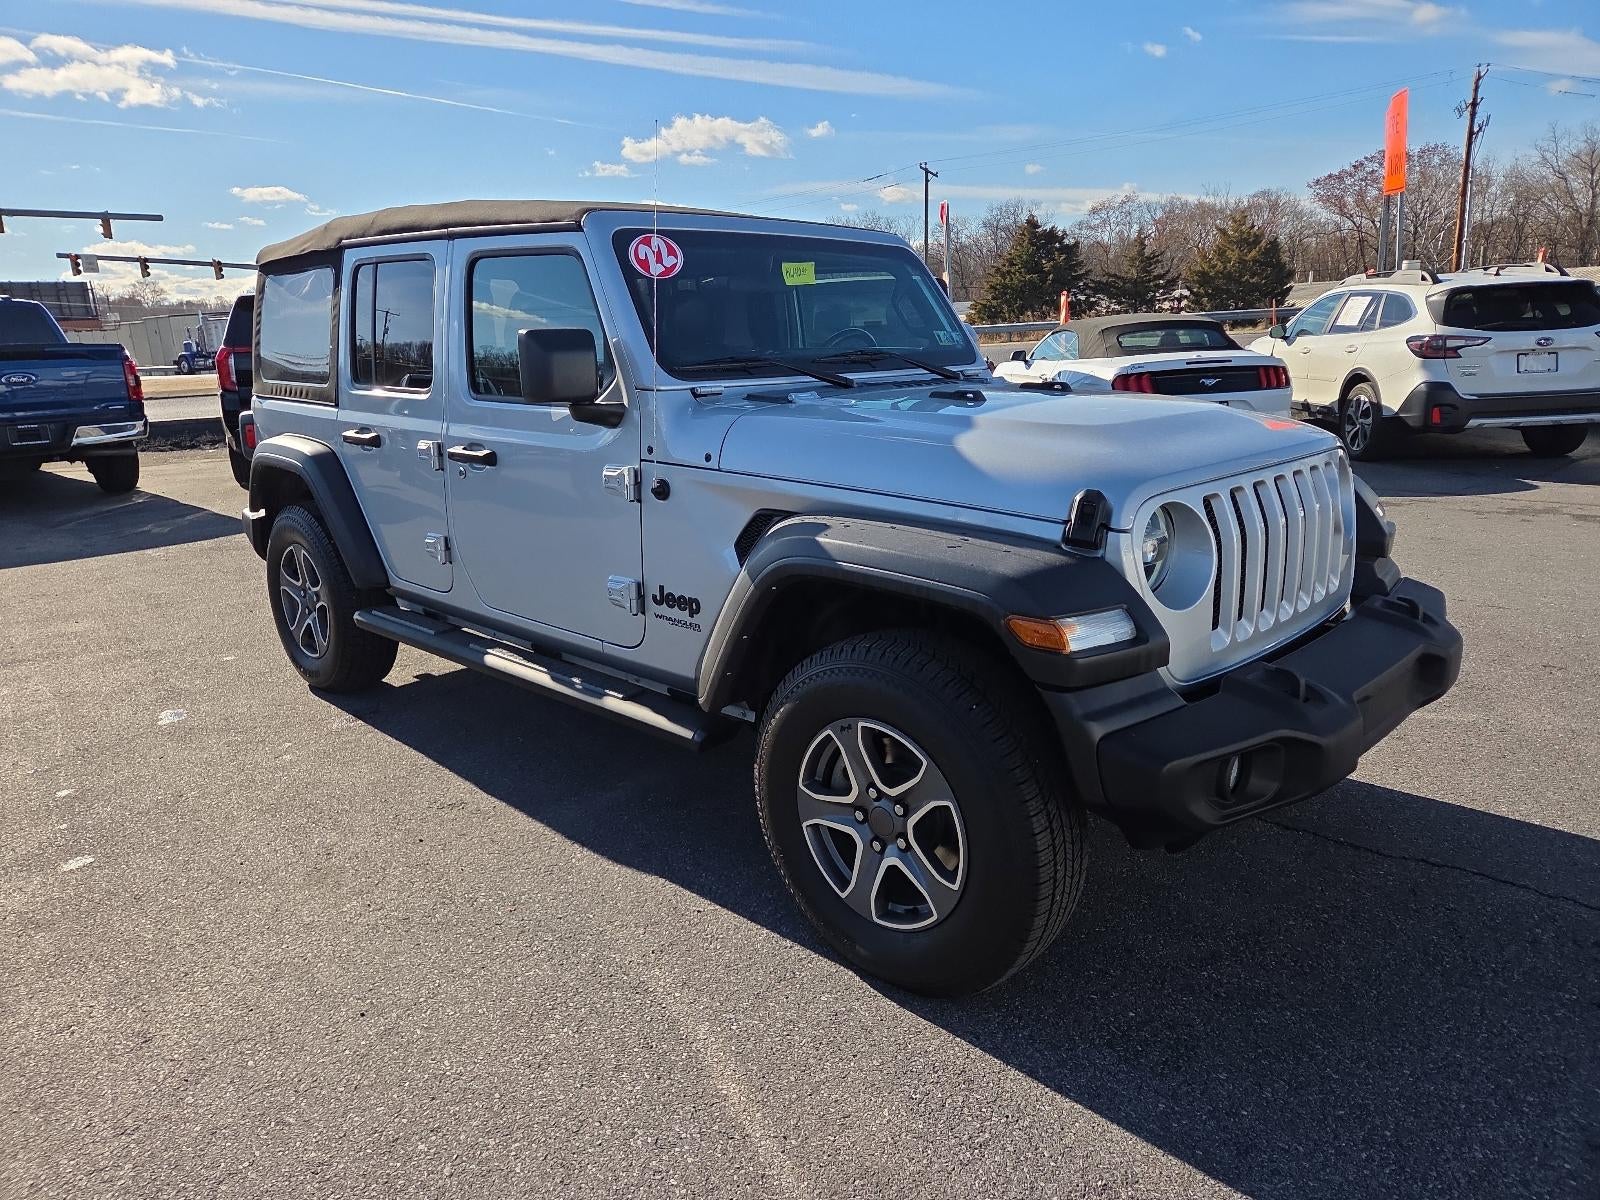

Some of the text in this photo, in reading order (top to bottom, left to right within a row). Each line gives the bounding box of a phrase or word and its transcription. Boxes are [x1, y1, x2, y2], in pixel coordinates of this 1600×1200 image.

[638, 236, 678, 276] 22
[651, 584, 701, 619] Jeep
[654, 612, 701, 630] WRANGLER
